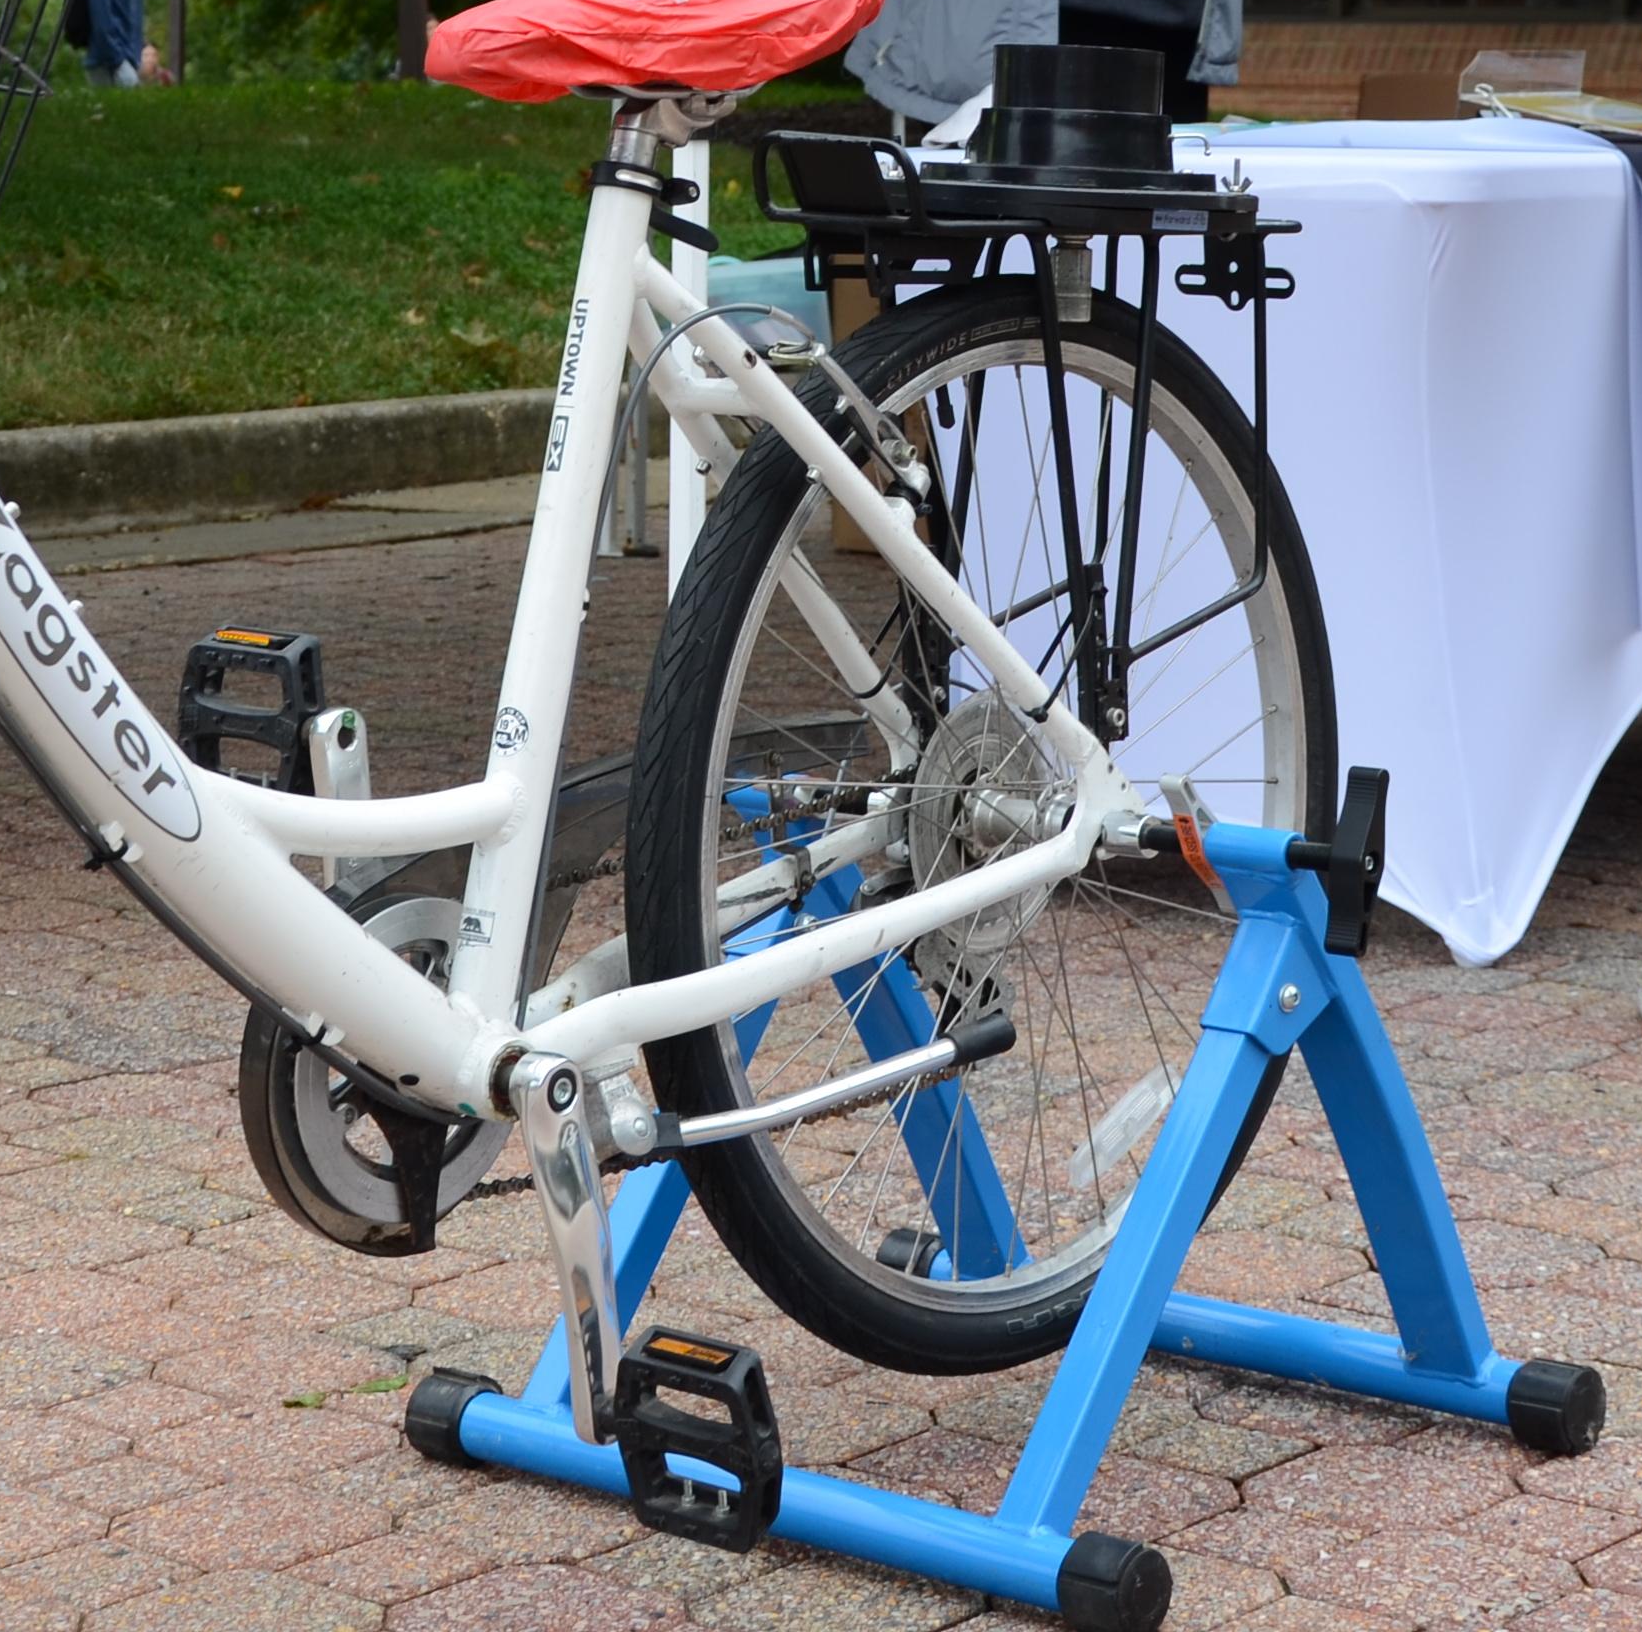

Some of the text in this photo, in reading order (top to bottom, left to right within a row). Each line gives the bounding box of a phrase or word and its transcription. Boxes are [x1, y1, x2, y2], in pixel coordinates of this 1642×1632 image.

[547, 298, 589, 471] UPTOWN EX
[886, 331, 968, 390] CITYWIDE
